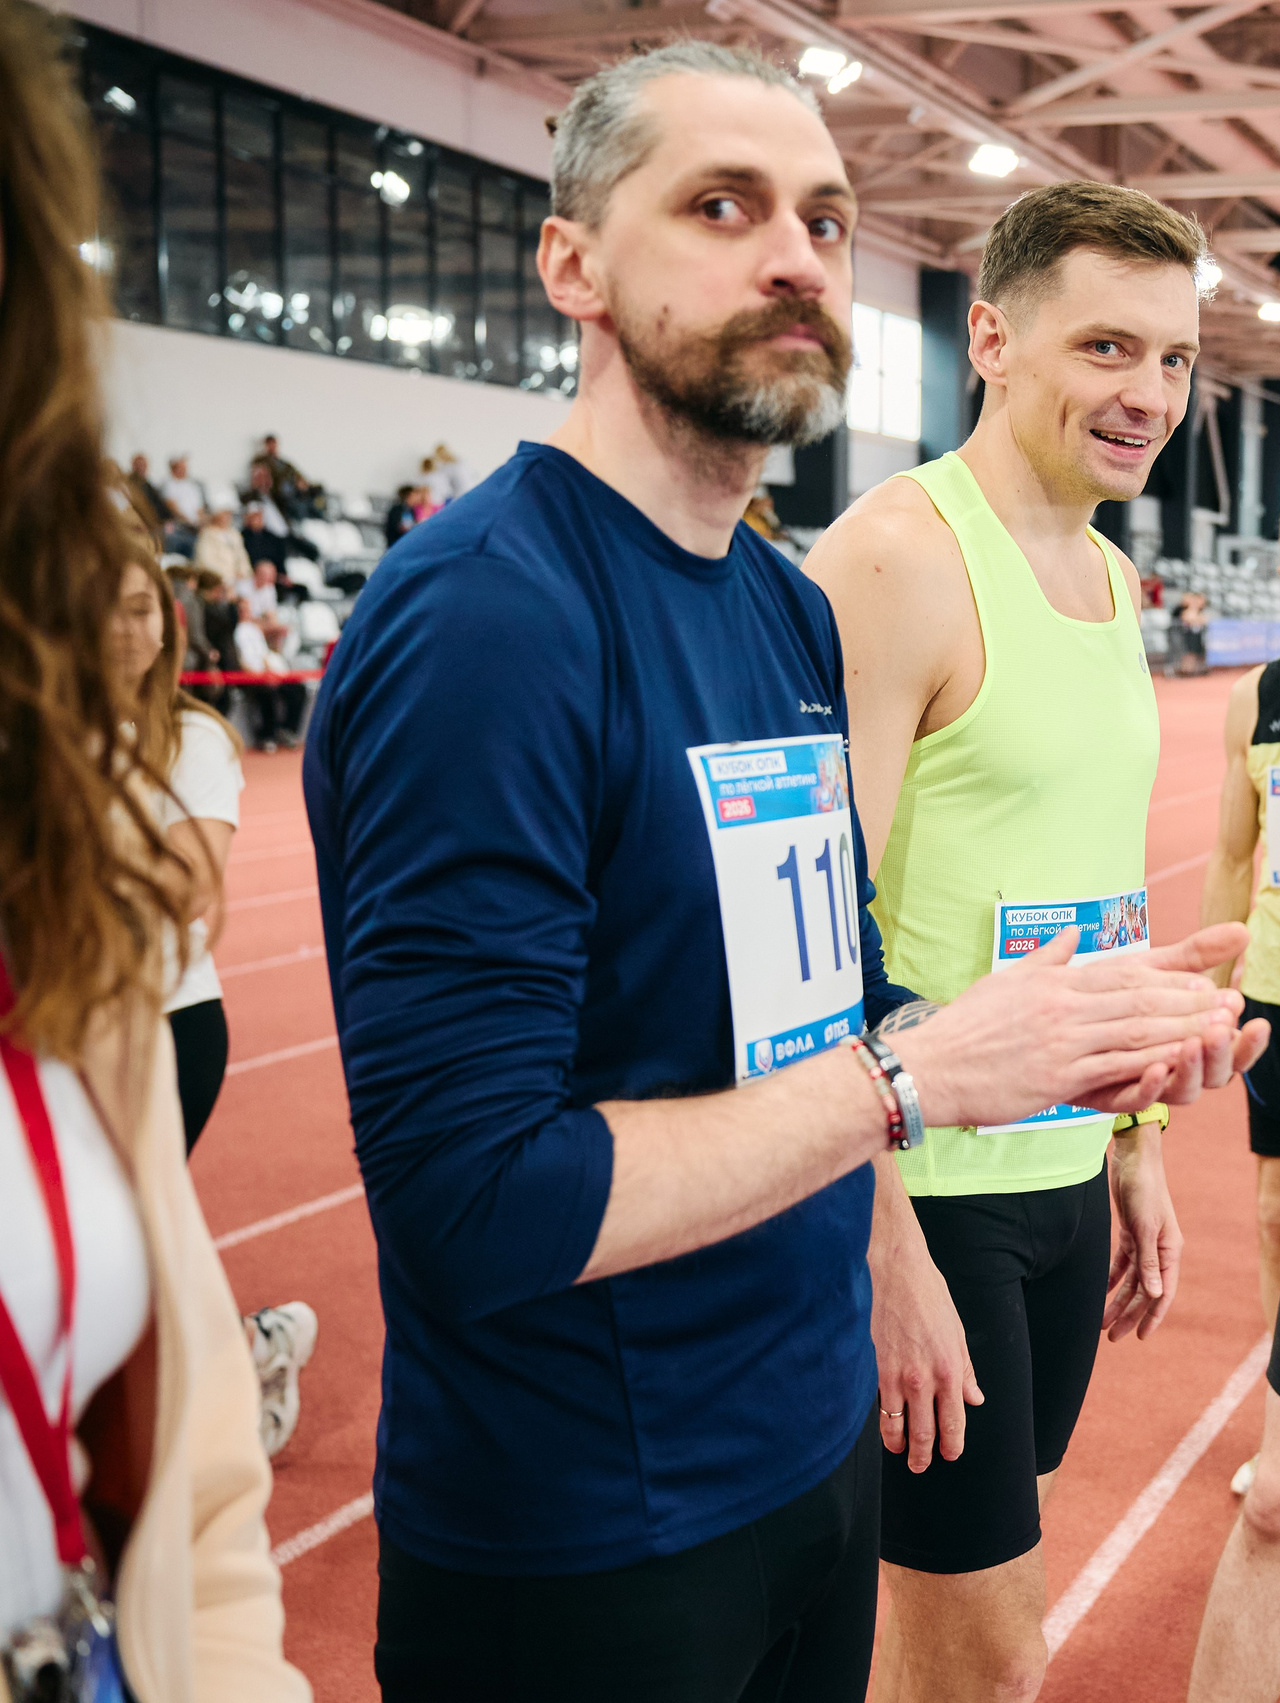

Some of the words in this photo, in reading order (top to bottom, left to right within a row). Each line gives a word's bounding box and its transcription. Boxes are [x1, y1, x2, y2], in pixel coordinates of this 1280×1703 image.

[716, 760, 754, 775] КУБОК
[756, 757, 782, 770] ОПК
[719, 783, 736, 796] по
[737, 776, 775, 794] лёгкой
[775, 773, 818, 789] атлетике
[722, 799, 752, 818] 2026
[777, 832, 857, 982] 110
[1011, 911, 1049, 922] КУБОК
[1051, 910, 1073, 920] ОПК
[1011, 928, 1024, 937] по
[1026, 924, 1061, 936] лёгкой
[1009, 940, 1035, 951] 2026
[775, 1033, 815, 1061] ВФЛА
